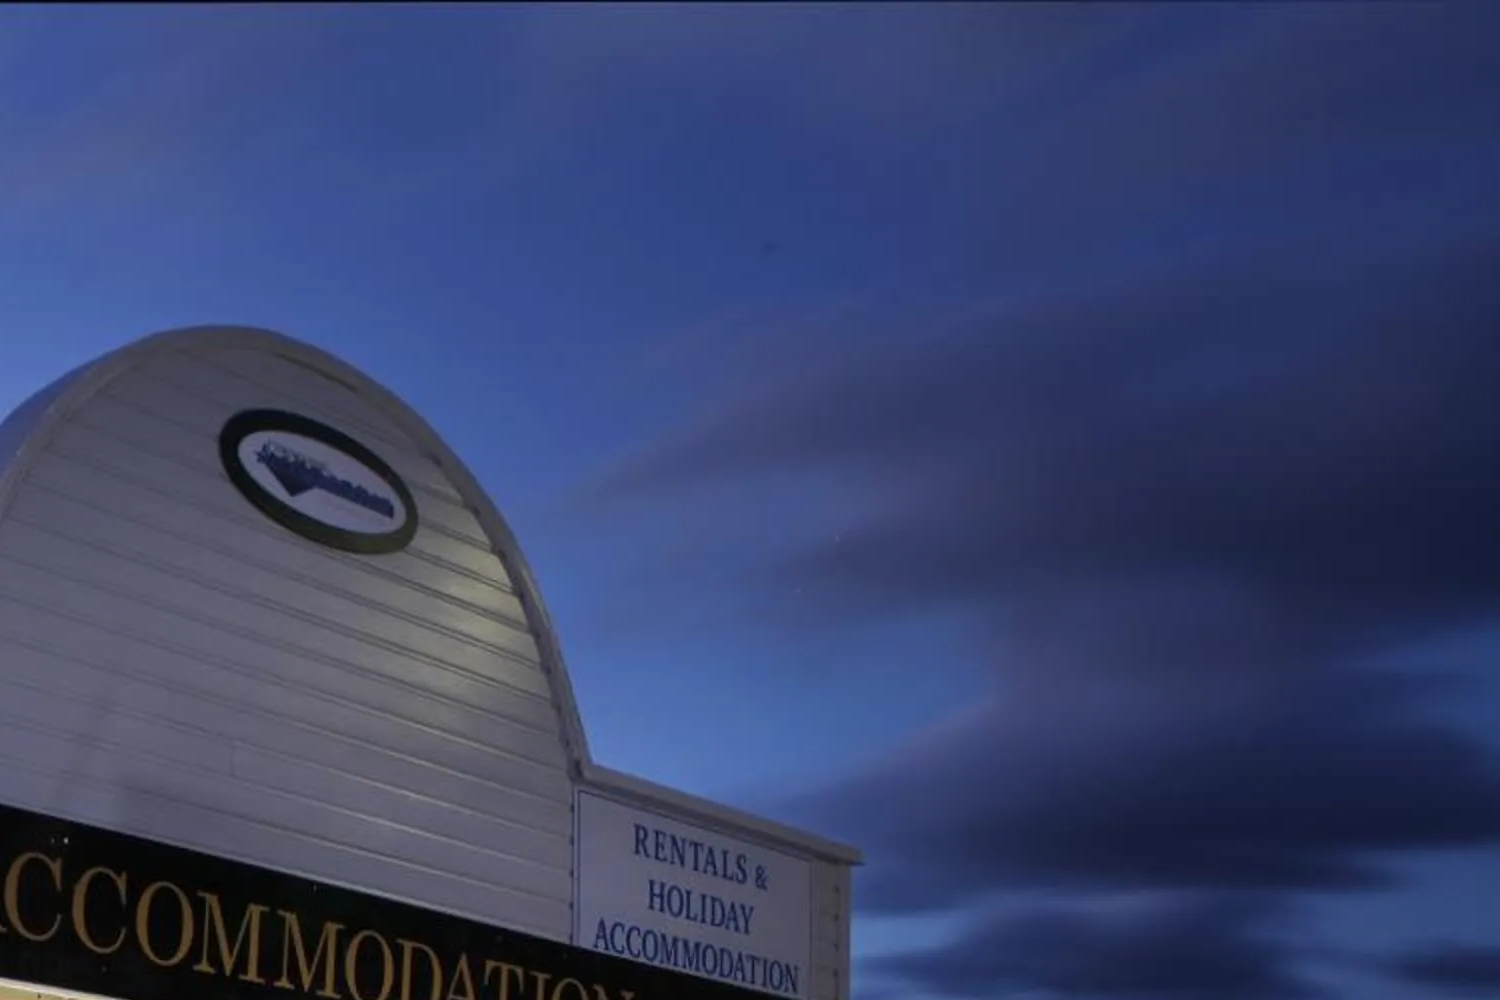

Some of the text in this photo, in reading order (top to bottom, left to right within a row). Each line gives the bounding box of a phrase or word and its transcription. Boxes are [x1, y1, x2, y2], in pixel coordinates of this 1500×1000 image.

[633, 822, 769, 891] RENTALS &
[647, 879, 755, 936] HOLIDAY
[592, 917, 800, 995] ACCOMMODATION
